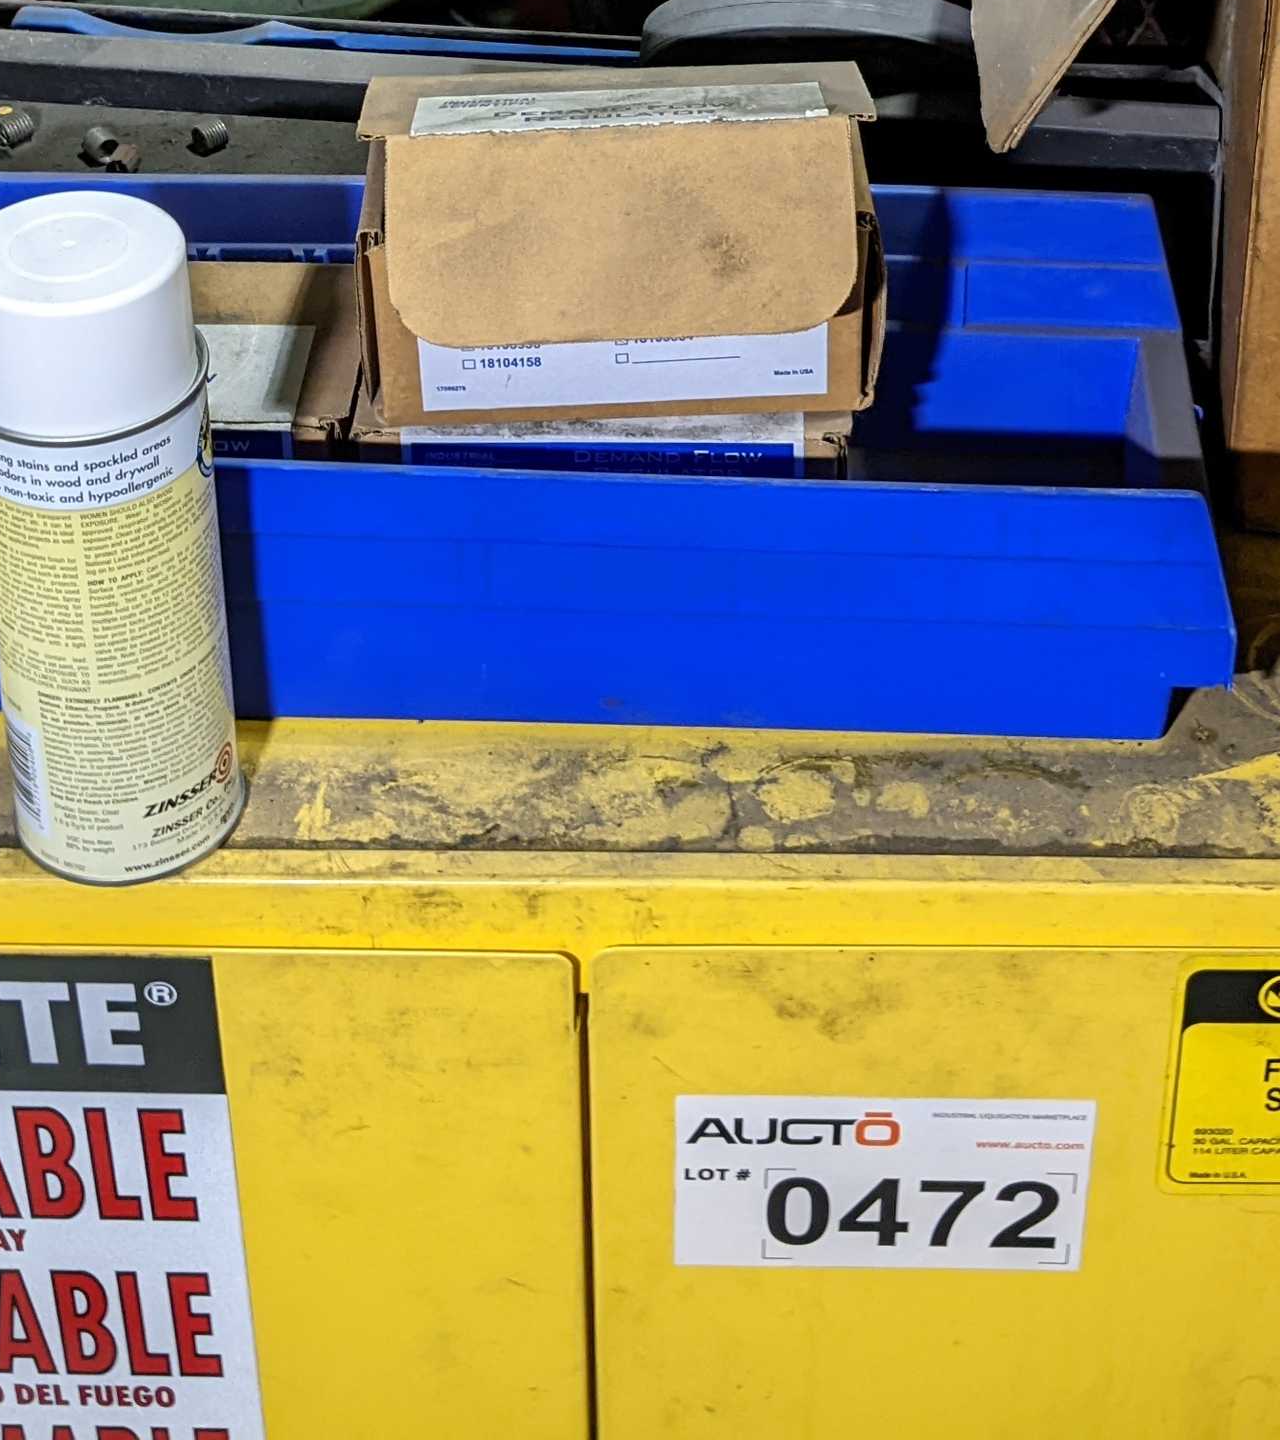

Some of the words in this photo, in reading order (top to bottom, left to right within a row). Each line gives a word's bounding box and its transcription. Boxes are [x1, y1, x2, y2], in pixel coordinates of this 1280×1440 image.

[523, 109, 718, 122] REGULATOR
[479, 356, 542, 369] 18104158
[213, 439, 252, 452] OW
[17, 458, 50, 472] stains
[54, 460, 79, 472] and
[83, 448, 138, 472] spackled
[142, 435, 172, 456] areas
[573, 450, 682, 464] DEMAND
[692, 449, 763, 463] FLOW
[31, 474, 42, 487] in
[45, 474, 81, 488] wood
[86, 471, 111, 486] and
[115, 454, 160, 481] drywall
[4, 484, 55, 504] non-toxic
[59, 490, 84, 504] and
[88, 466, 174, 504] hypoallergenic
[80, 511, 108, 520] WOMEN
[109, 503, 138, 516] SHOULD
[138, 497, 156, 508] ALSO
[81, 527, 114, 537] approved
[115, 530, 133, 539] Clean
[94, 550, 118, 560] protect
[120, 542, 146, 554] yourself
[87, 578, 105, 586] HOW
[108, 577, 118, 585] TO
[143, 766, 218, 819] ZINSSER
[96, 823, 124, 833] product
[151, 804, 204, 839] ZINSSER
[93, 846, 116, 855] weight
[931, 1111, 979, 1119] INDUSTRIAL
[980, 1112, 1031, 1120] LIQUIDATION
[1032, 1113, 1088, 1121] MARKETPLACE
[975, 1139, 1085, 1151] www.aucto.com
[1214, 1147, 1249, 1155] LITER
[684, 1167, 729, 1181] LOT
[735, 1168, 751, 1180] #
[766, 1176, 1060, 1249] 0472
[16, 1382, 70, 1407] DEL
[78, 1384, 175, 1408] FUEGO
